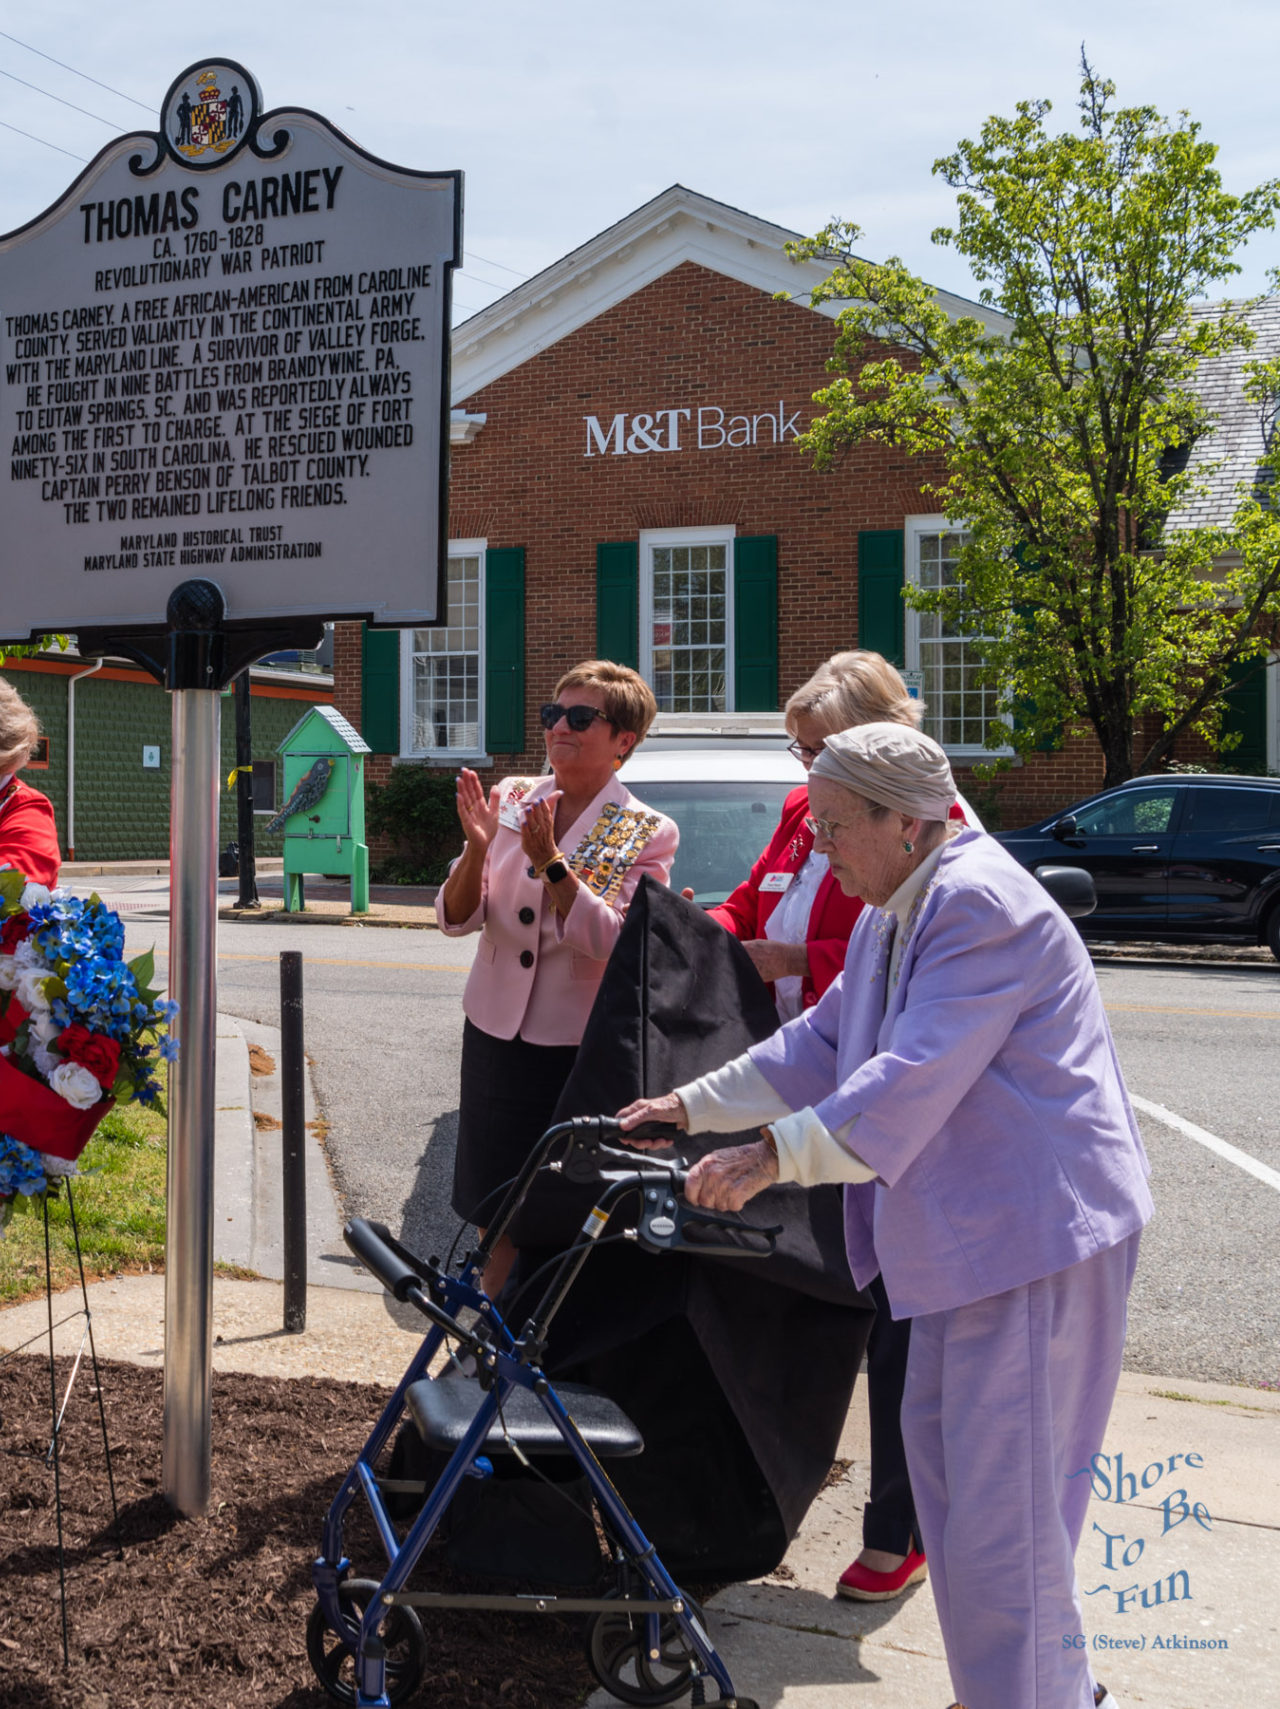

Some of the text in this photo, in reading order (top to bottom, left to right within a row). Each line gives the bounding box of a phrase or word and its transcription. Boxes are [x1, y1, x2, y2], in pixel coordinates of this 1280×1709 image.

[79, 165, 343, 243] THOMAS CARNEY
[94, 239, 325, 291] REVOLUTIONARY WAR PATRIOT
[152, 223, 263, 259] CA. 1760-1828
[4, 311, 58, 337] THOMAS
[120, 302, 130, 323] A
[134, 297, 168, 322] FREE
[172, 279, 309, 317] AFRICAN-AMERICAN
[314, 273, 352, 300] FROM
[358, 264, 431, 295] CAROLINE
[75, 326, 127, 352] SERVED
[131, 316, 206, 346] VALIANTLY
[210, 314, 223, 337] IN
[229, 310, 258, 334] THE
[262, 298, 363, 330] CONTINENTAL
[369, 291, 415, 319] ARMY
[5, 361, 39, 384] WITH
[44, 354, 70, 381] THE
[74, 348, 146, 377] MARYLAND
[150, 344, 183, 369] LINE.
[191, 342, 202, 364] A
[207, 333, 278, 362] SURVIVOR
[283, 330, 303, 354] OF
[308, 323, 365, 351] VALLEY
[15, 409, 33, 431] TO
[37, 404, 83, 429] EUTAW
[183, 391, 211, 415] AND
[216, 387, 246, 412] WAS
[251, 377, 346, 408] REPORTEDLY
[348, 370, 410, 399] ALWAYS
[26, 385, 42, 407] HE
[47, 378, 99, 405] FOUGHT
[103, 376, 116, 398] IN
[121, 372, 150, 397] NINE
[154, 366, 219, 393] BATTLES
[224, 360, 262, 386] FROM
[11, 397, 413, 456] AMONG THE FIRST TO CHARGE. AT THE SIEGE OF FORT
[11, 452, 88, 480] NINETY-SIX
[92, 451, 105, 473] IN
[110, 446, 156, 471] SOUTH
[244, 436, 262, 460] HE
[268, 430, 336, 458] RESCUED
[341, 423, 413, 451] WOUNDED
[583, 400, 801, 457] M&T Bank
[41, 453, 369, 501] CAPTAIN PERRY BENSON OF TALBOT COUNTY.
[63, 482, 347, 524] THE TWO REMAINED LIFELONG FRIENDS.
[83, 541, 321, 571] MARYLAND STATE HIGHWAY ADMINISTRATION
[120, 525, 282, 551] MARYLAND HISTORICAL TRUST
